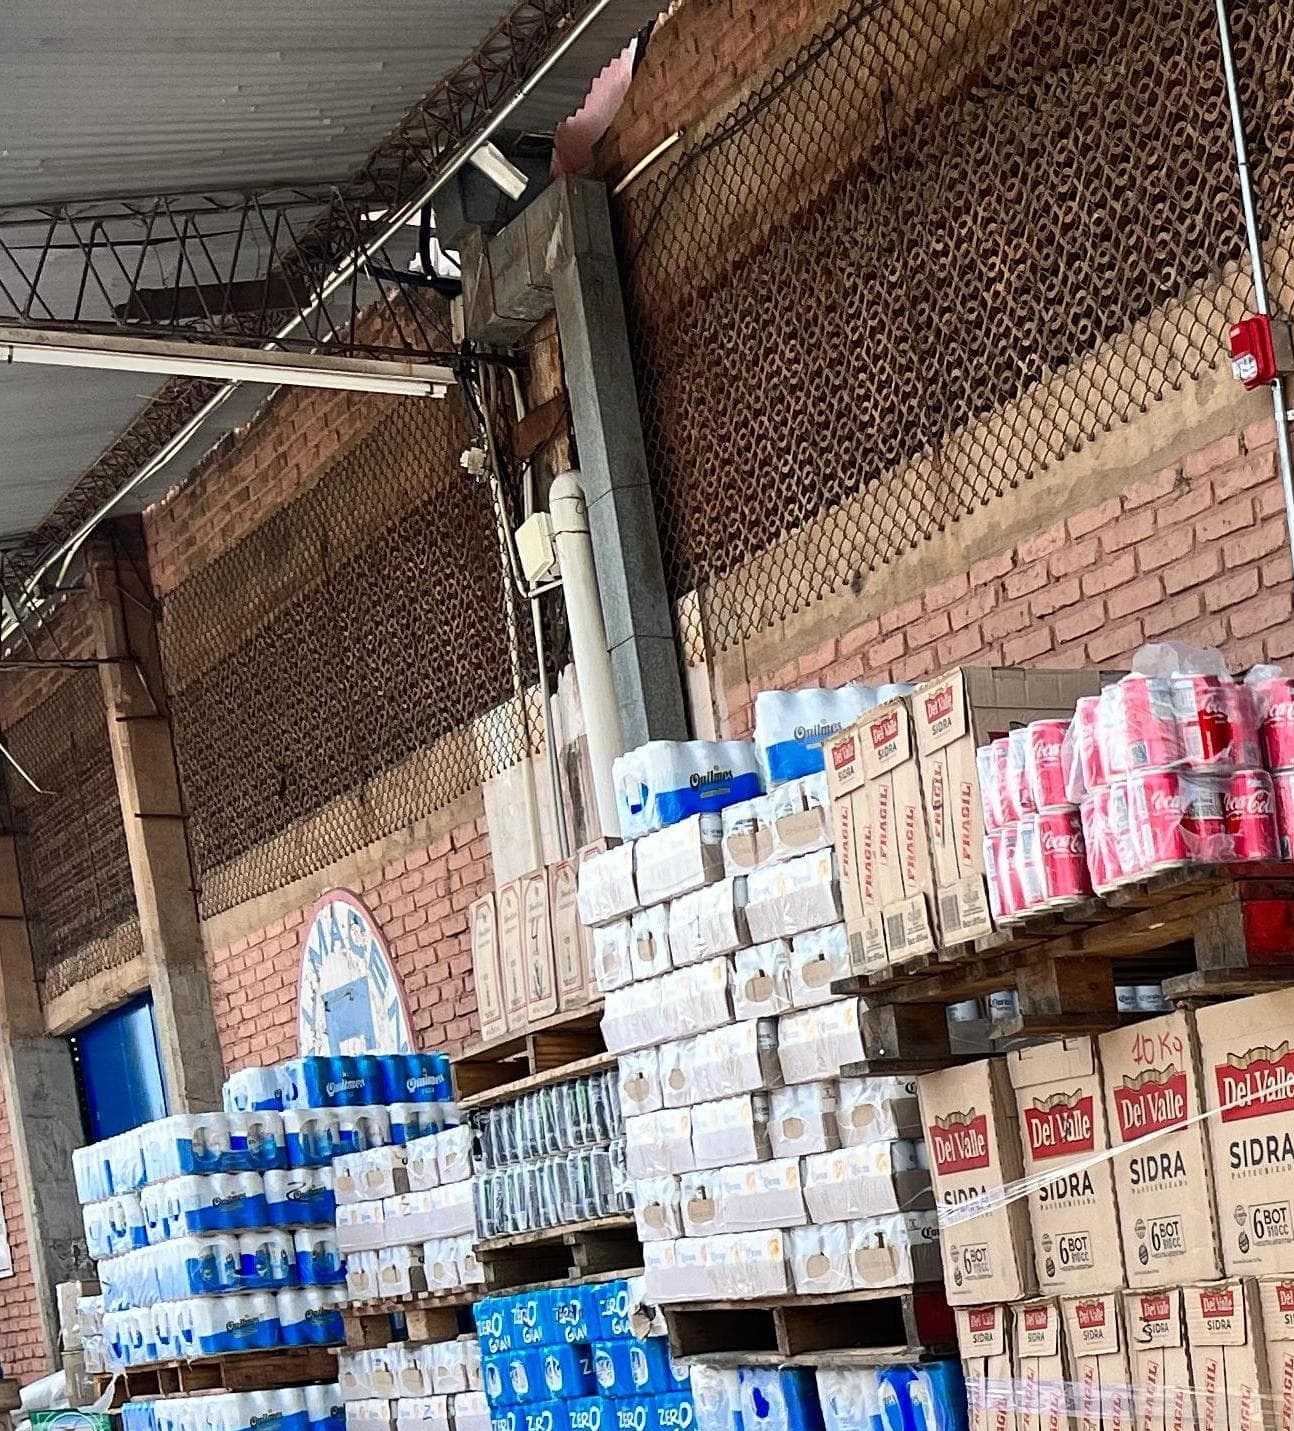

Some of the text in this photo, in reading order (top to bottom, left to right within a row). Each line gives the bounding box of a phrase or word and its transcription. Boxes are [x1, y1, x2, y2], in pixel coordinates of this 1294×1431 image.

[690, 765, 733, 789] Quilmes
[961, 783, 972, 862] FRAGIL
[1120, 1088, 1184, 1127] Del Valle
[1224, 1078, 1251, 1107] Del
[1130, 1151, 1186, 1185] SIDRA
[1254, 1208, 1288, 1239] 6 BOT
[658, 1401, 693, 1429] ZERO
